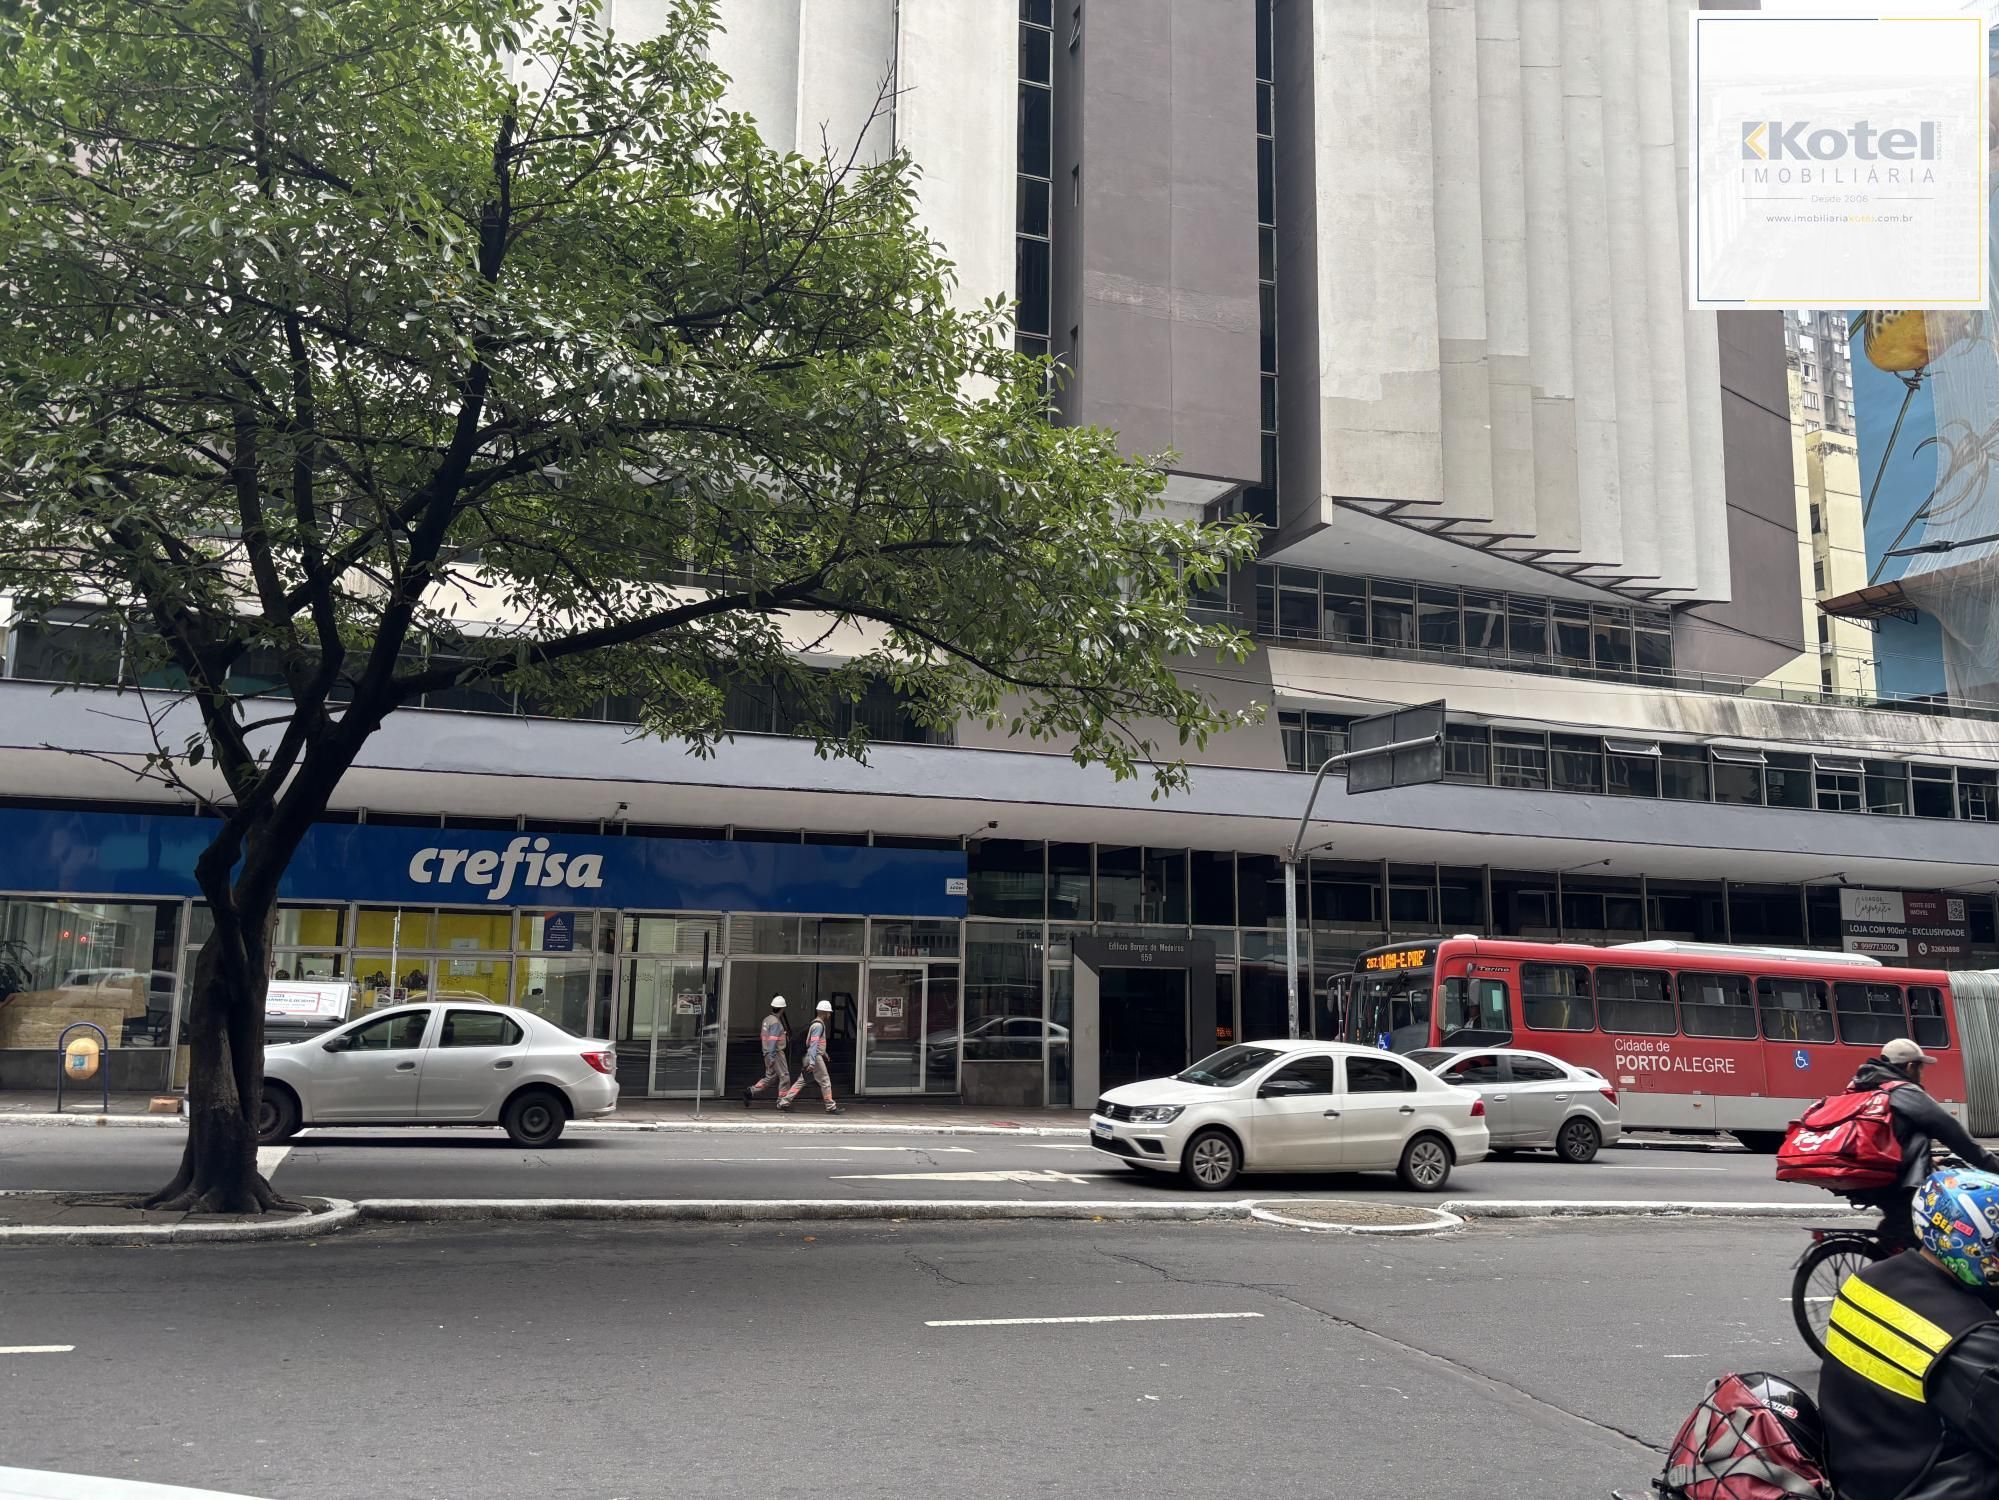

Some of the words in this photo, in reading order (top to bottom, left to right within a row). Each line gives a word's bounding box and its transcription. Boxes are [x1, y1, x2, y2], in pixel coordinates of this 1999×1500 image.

[409, 836, 604, 901] crefisa
[1849, 924, 1868, 933] LOJA
[1868, 925, 1886, 934] COM
[1912, 927, 1965, 937] EXCLUSIVIDADE
[1614, 1038, 1654, 1052] Cidade
[1656, 1040, 1670, 1053] de
[1615, 1054, 1671, 1071] PORTO
[1673, 1056, 1736, 1074] ALEGRE
[1931, 1211, 1954, 1235] BEE
